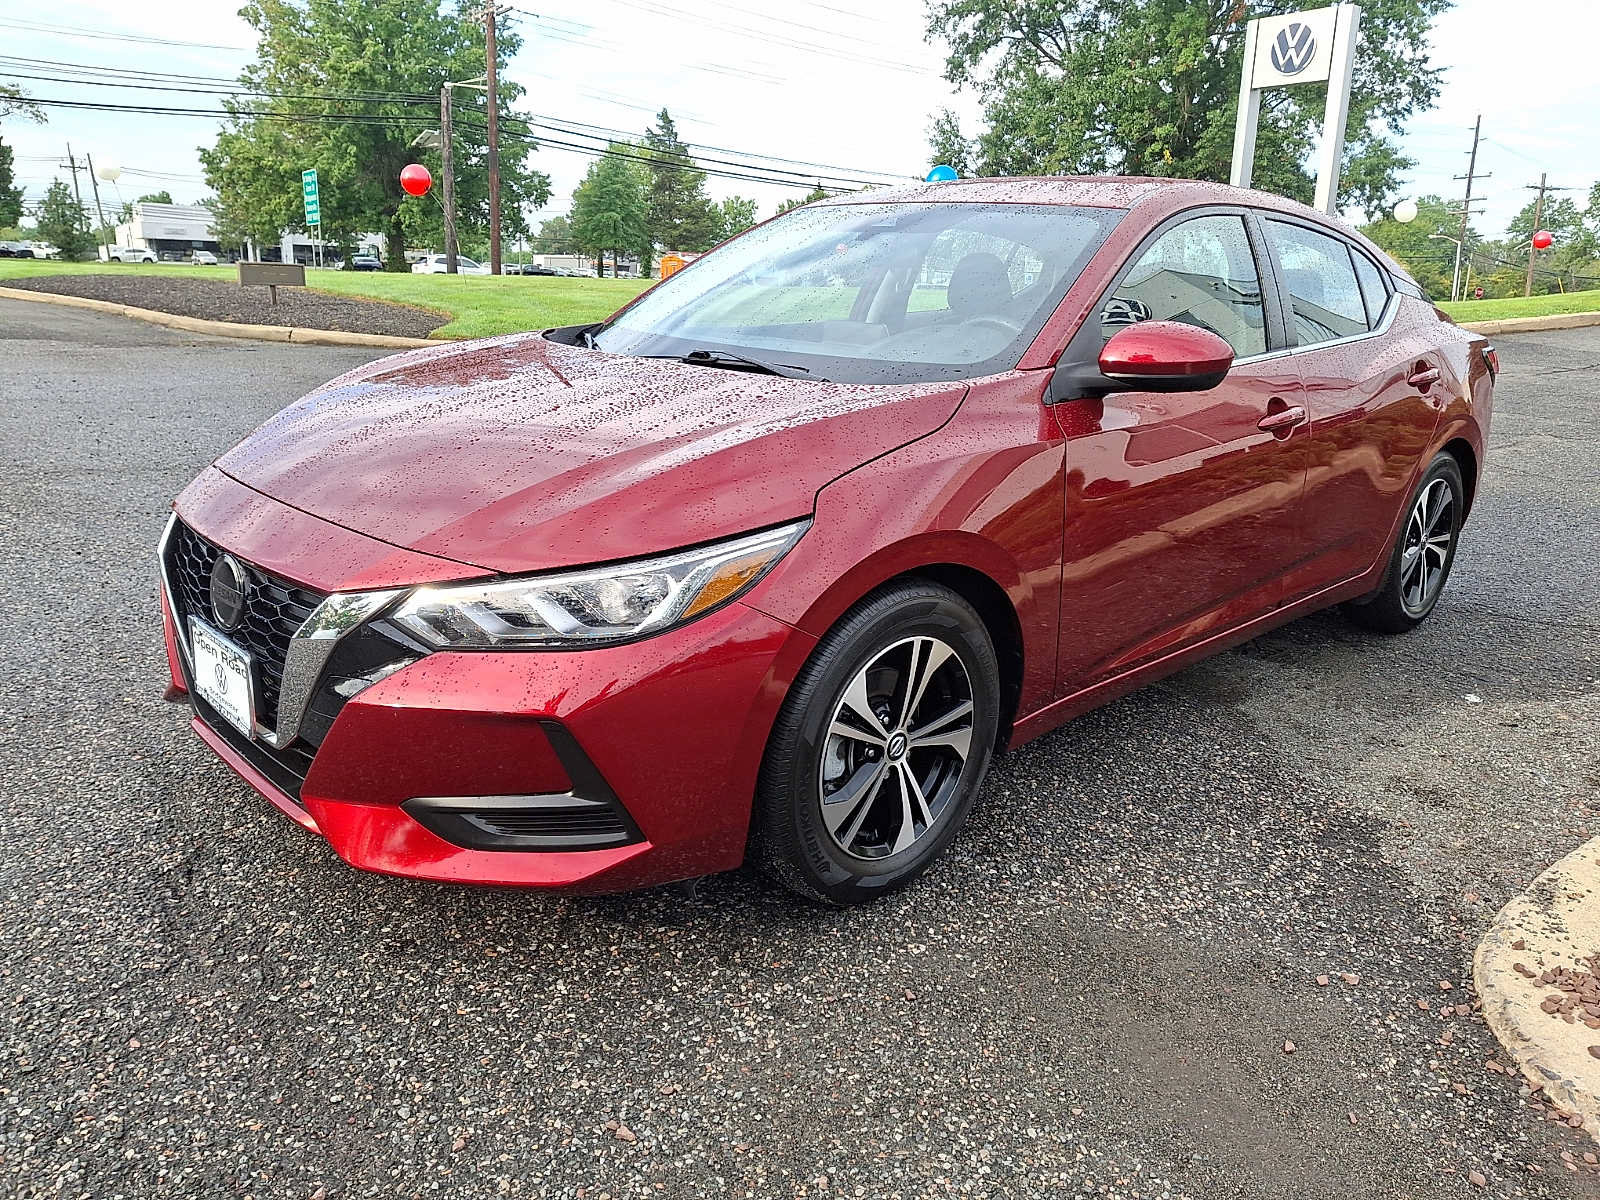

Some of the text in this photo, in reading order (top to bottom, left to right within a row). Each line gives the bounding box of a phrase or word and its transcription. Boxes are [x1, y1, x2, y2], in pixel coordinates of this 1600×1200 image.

[1271, 22, 1317, 75] VW
[194, 630, 248, 679] Open Road
